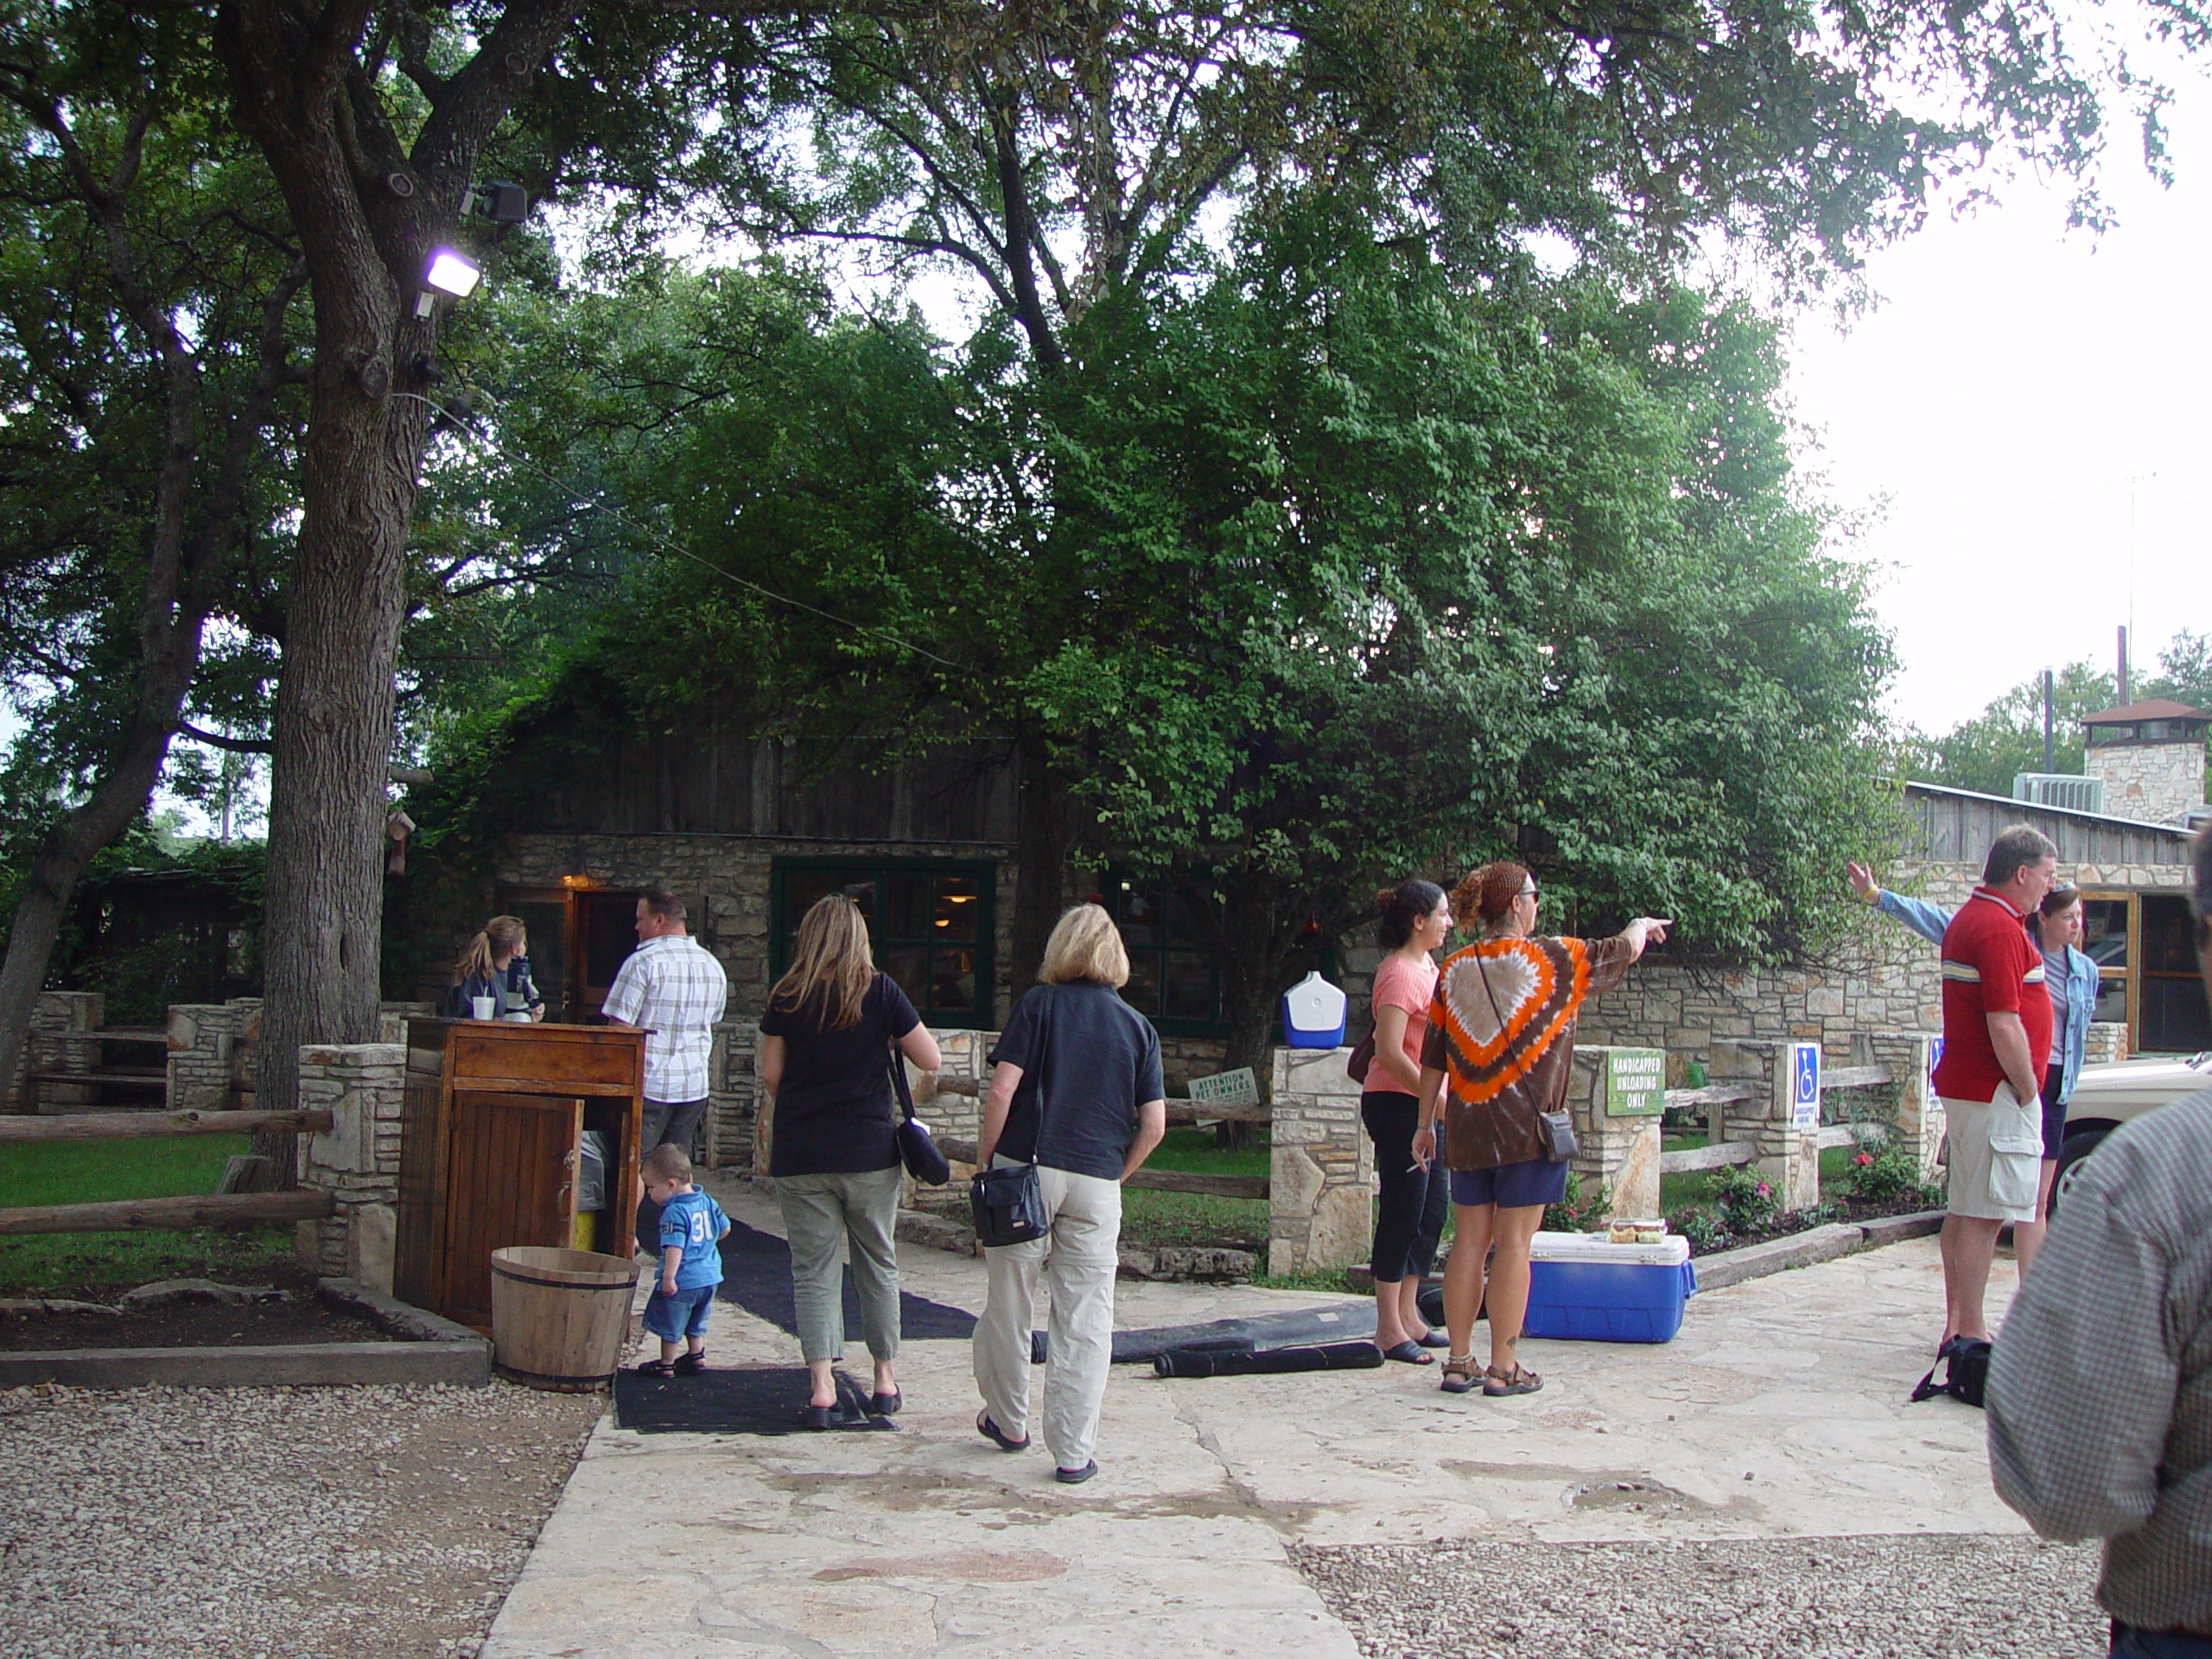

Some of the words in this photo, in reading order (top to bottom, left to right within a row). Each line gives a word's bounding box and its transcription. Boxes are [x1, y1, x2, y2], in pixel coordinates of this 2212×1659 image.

[1613, 1057, 1661, 1074] HANDICAPPED
[1198, 1071, 1244, 1090] ATTENTION
[1617, 1075, 1656, 1090] UNLOADING
[1195, 1089, 1210, 1100] PET
[1213, 1079, 1250, 1096] OWNERS
[1626, 1092, 1647, 1109] ONLY
[663, 1222, 673, 1234] 31
[691, 1209, 714, 1243] 31
